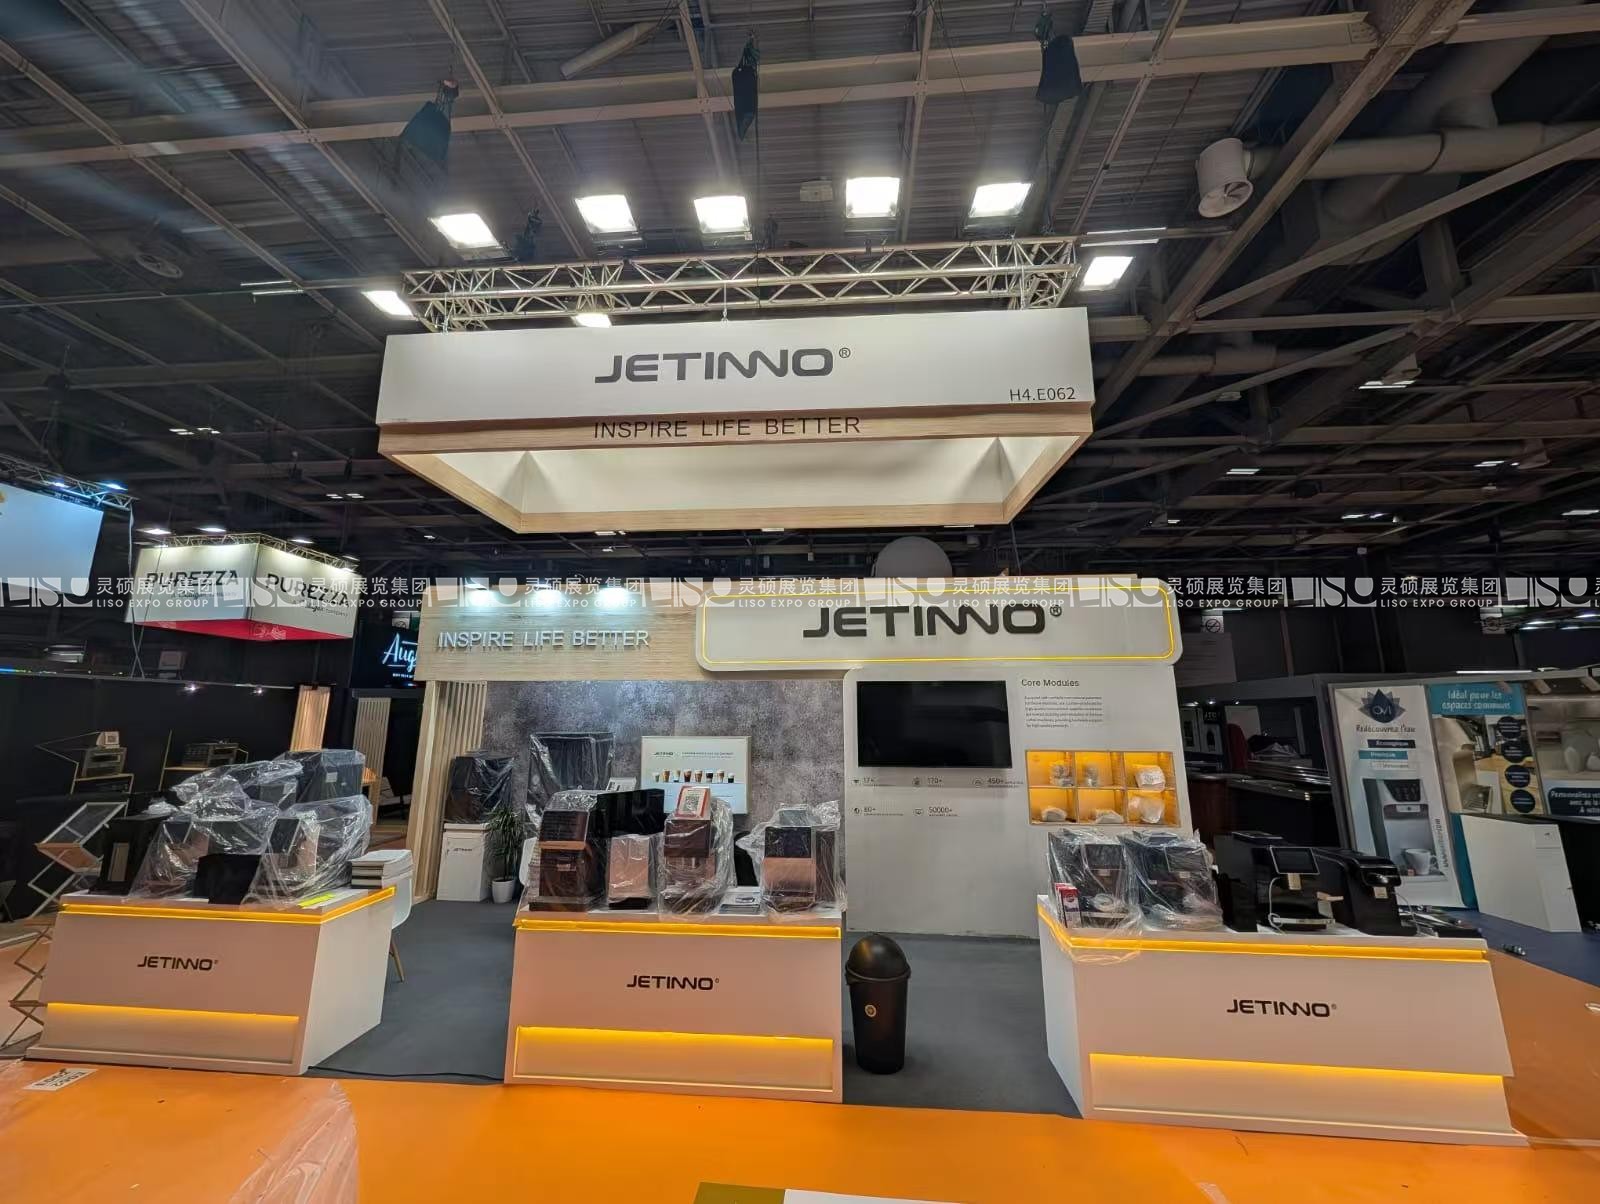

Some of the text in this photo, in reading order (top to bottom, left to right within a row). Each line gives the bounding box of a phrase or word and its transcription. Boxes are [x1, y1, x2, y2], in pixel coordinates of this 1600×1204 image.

[1009, 387, 1076, 402] H4.E062
[593, 416, 861, 439] INSPIRE LIFE BETTER
[437, 630, 651, 650] INSPIRE LIFE BETTER
[1021, 679, 1080, 687] Core Modules
